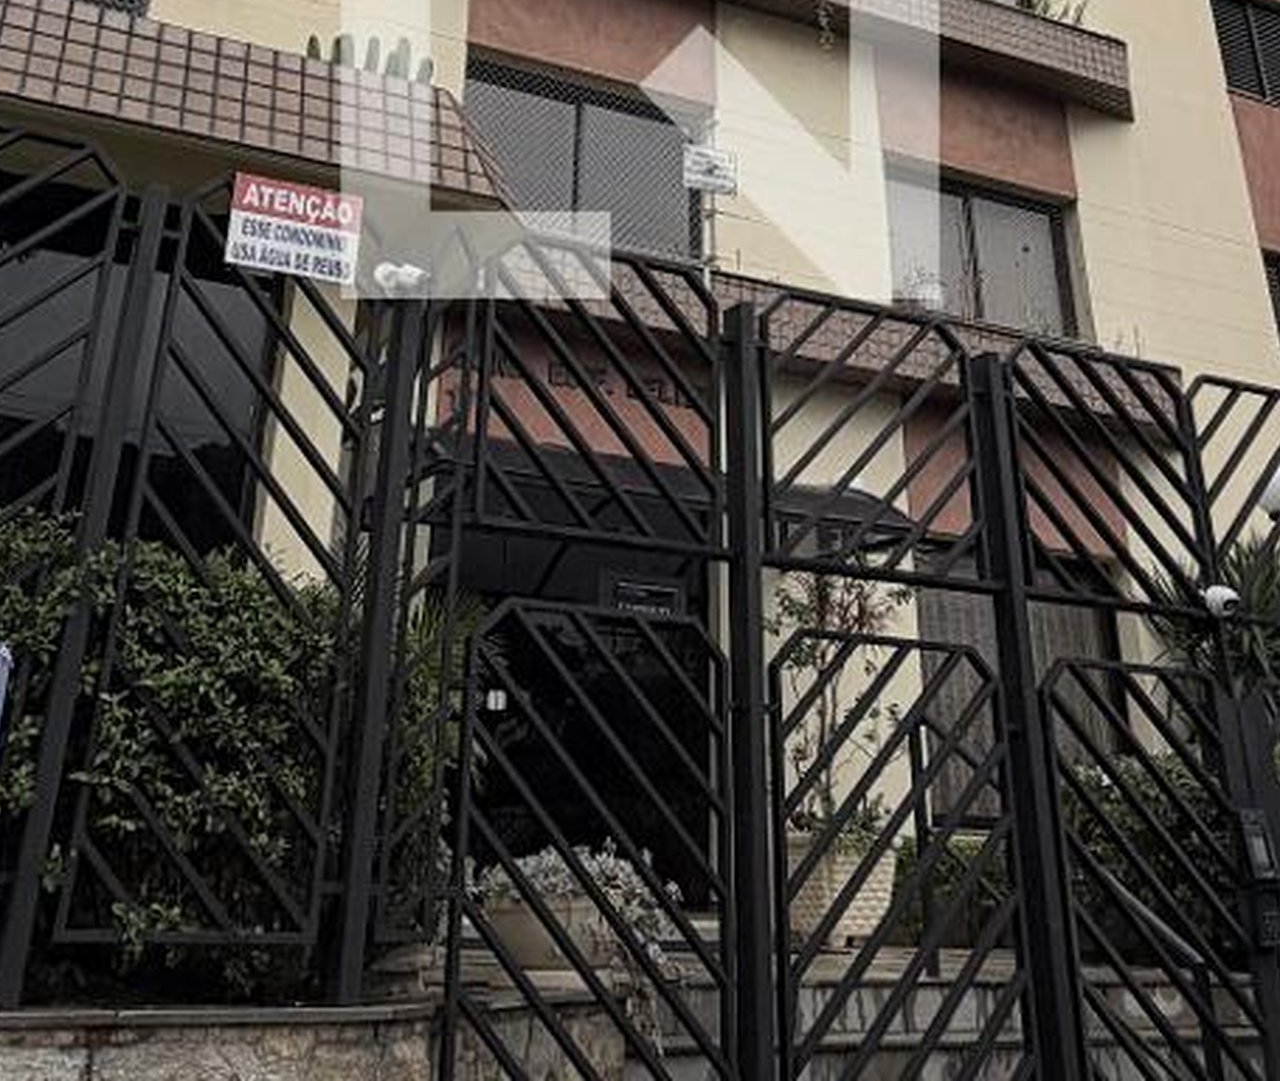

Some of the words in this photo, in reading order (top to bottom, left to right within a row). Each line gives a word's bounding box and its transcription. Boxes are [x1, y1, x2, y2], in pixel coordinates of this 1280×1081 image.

[242, 183, 352, 224] ATENÇÃO
[241, 218, 271, 240] ESSE
[231, 241, 257, 262] USA
[295, 253, 310, 272] DE
